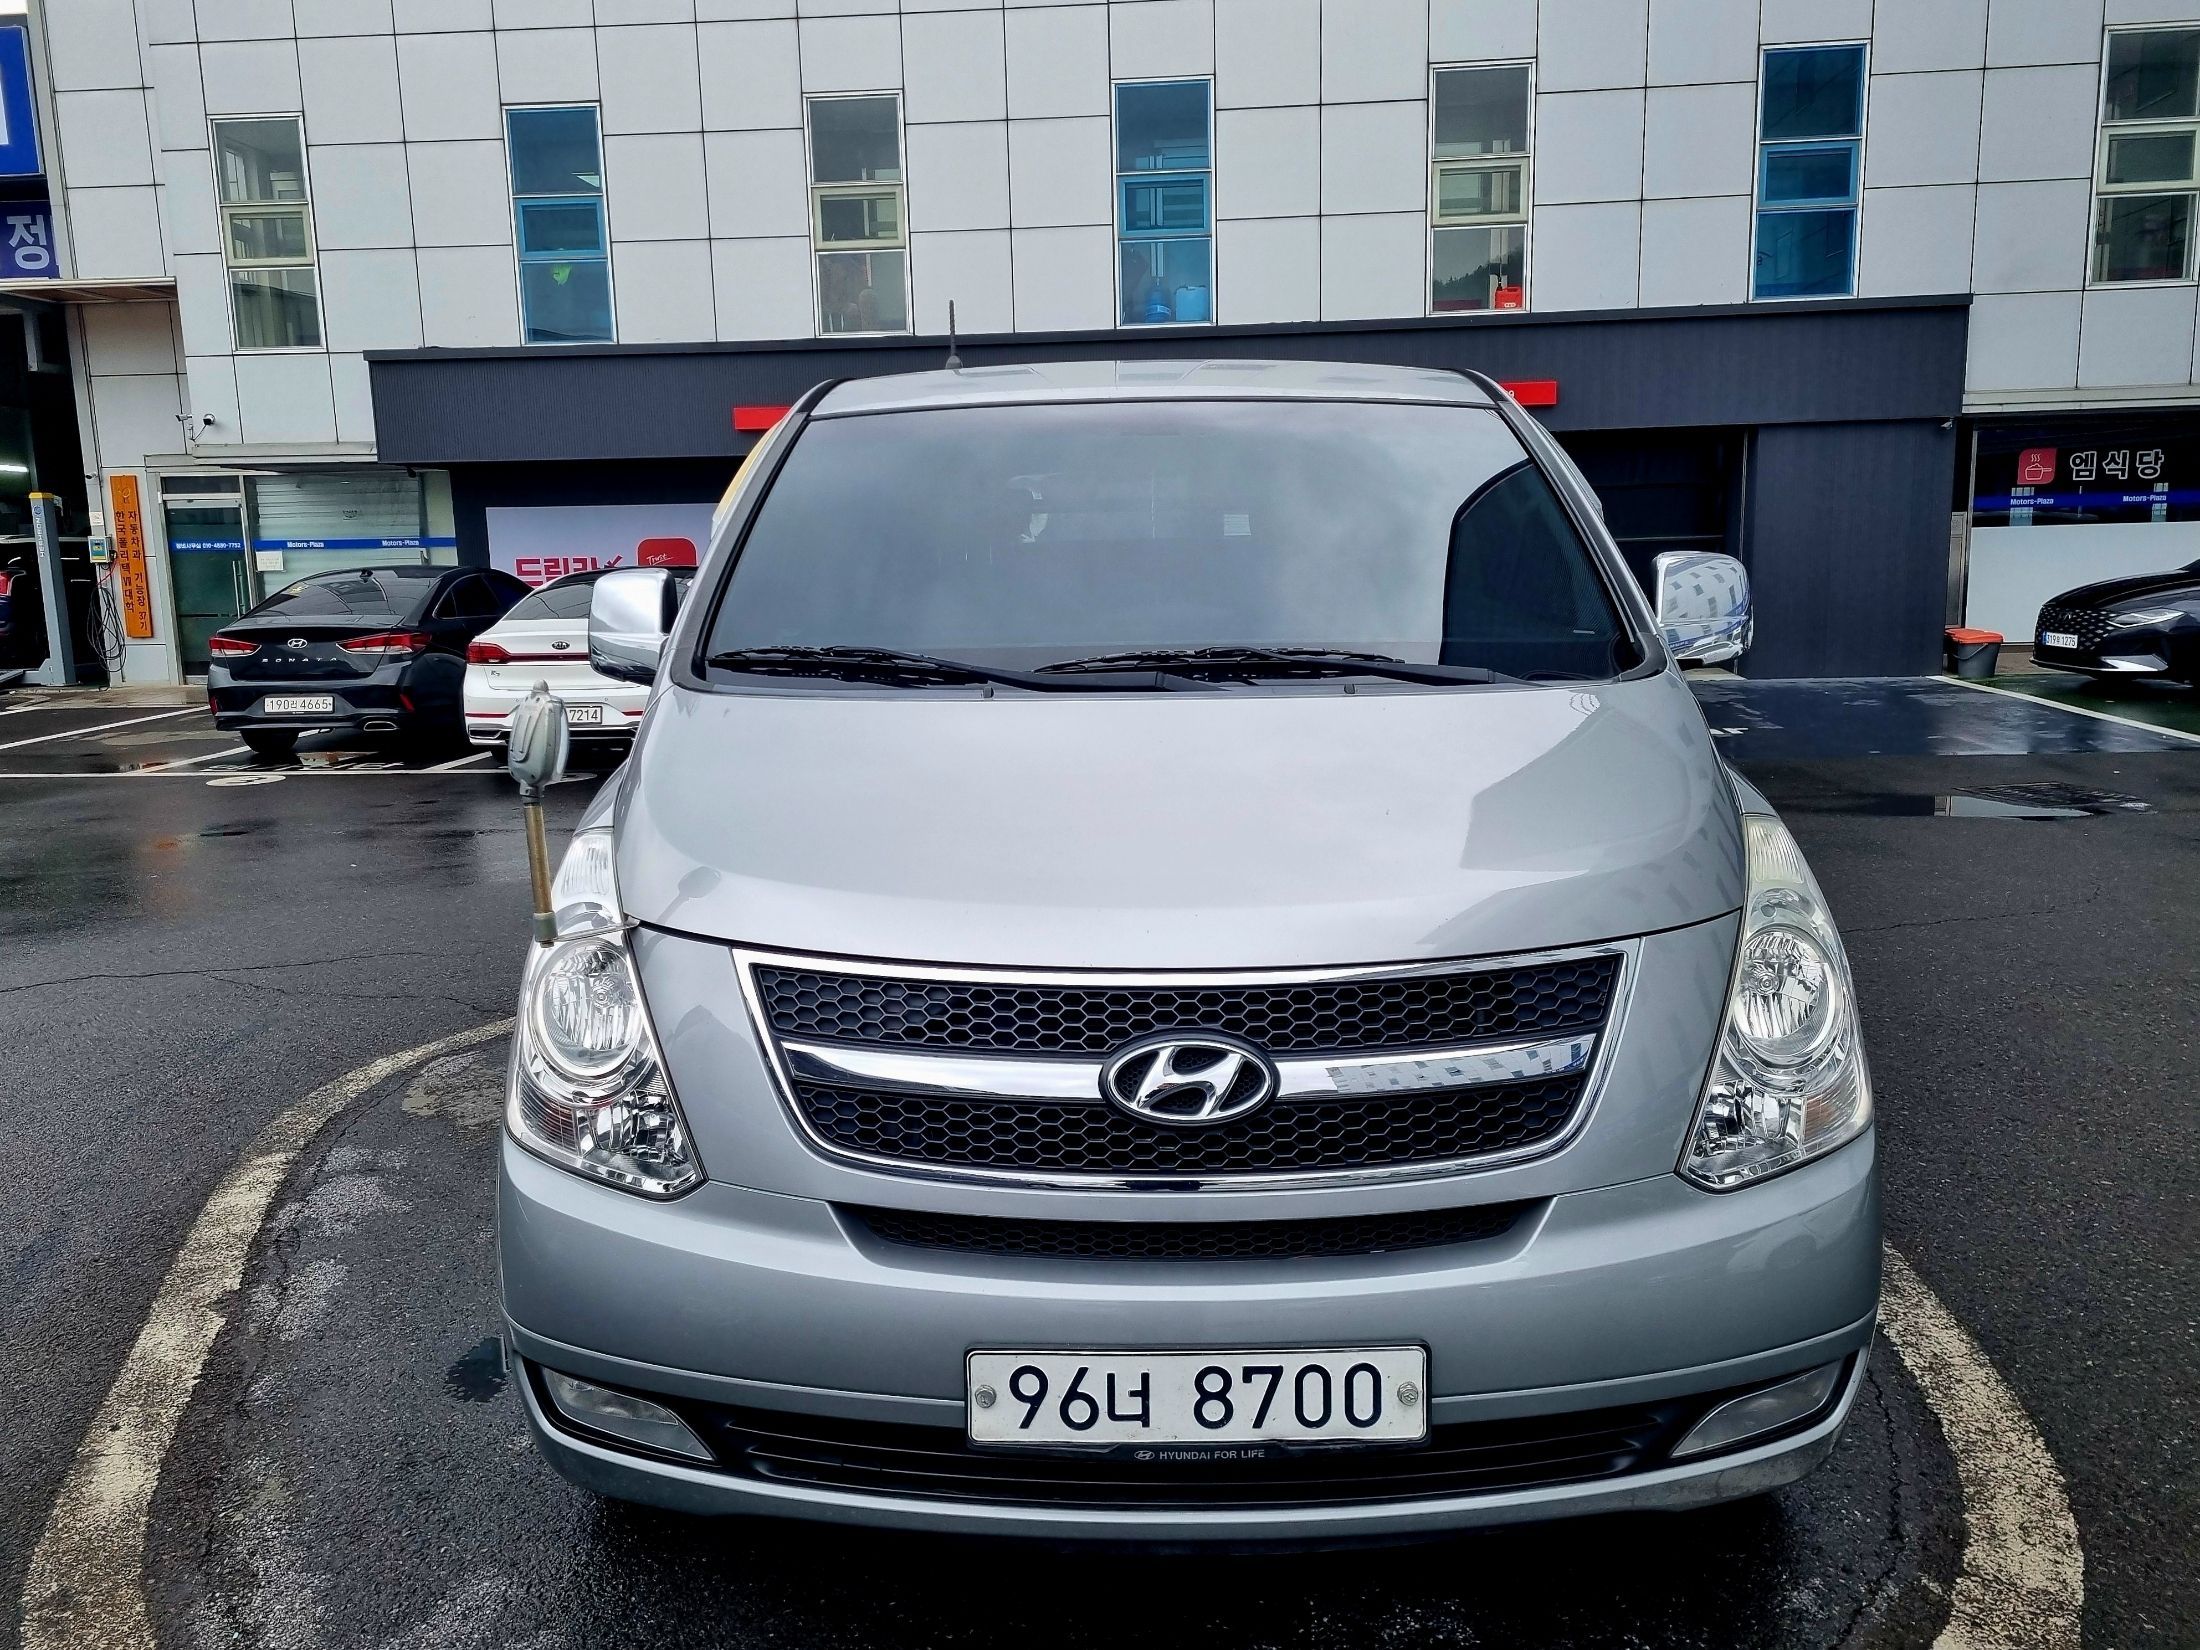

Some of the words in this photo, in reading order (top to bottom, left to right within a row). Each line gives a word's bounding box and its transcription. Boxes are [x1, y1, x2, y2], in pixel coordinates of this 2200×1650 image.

[7, 214, 50, 270] 정
[2069, 449, 2165, 481] 엠식당
[2010, 497, 2054, 505] Motors-Plaza
[2122, 494, 2167, 502] Motors-Plaza
[299, 698, 328, 710] 4665
[569, 709, 599, 721] 7214
[1008, 1364, 1151, 1431] 96너
[1192, 1362, 1383, 1430] 8700
[1159, 1451, 1211, 1460] HYUNDAI
[1214, 1450, 1237, 1459] FOR
[1241, 1449, 1265, 1459] LIFE
